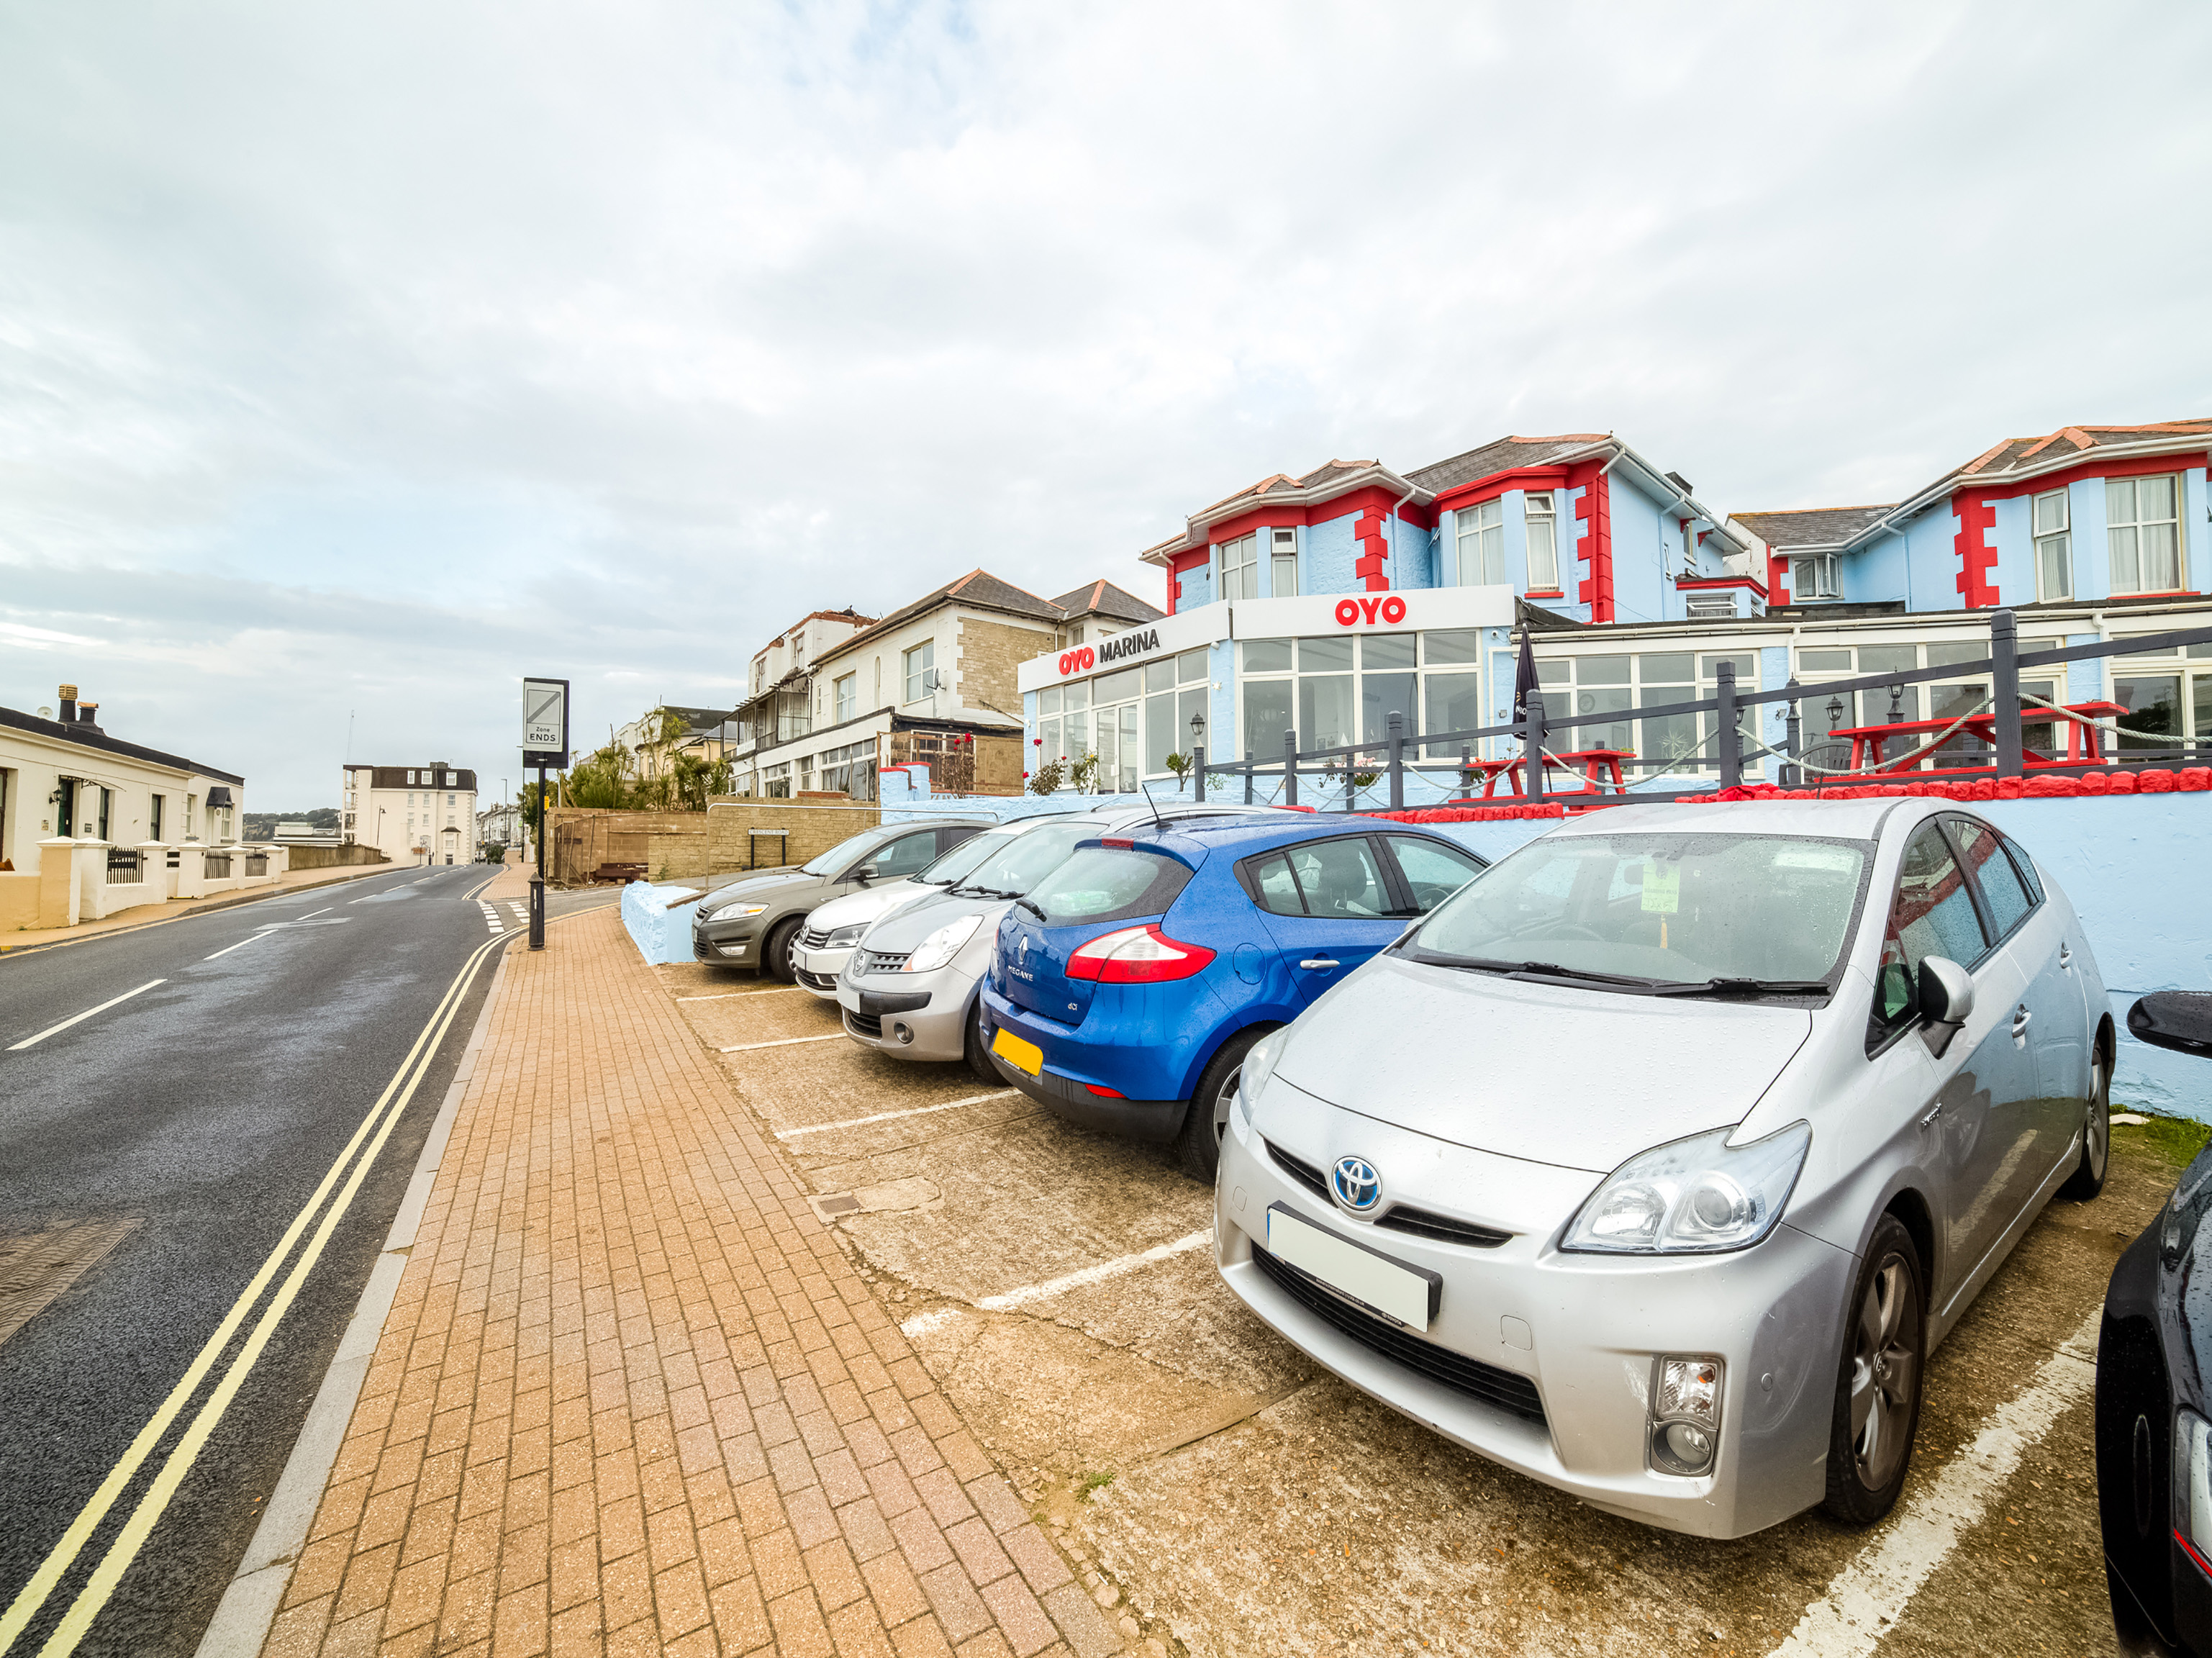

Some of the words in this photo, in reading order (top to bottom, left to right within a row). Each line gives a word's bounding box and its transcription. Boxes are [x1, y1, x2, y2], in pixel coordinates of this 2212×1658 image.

[1335, 596, 1407, 627] OYO
[1059, 646, 1095, 676] OYO
[1100, 628, 1161, 663] MARINA
[530, 733, 556, 742] ENDS
[1007, 965, 1034, 982] MEGANE
[1387, 1314, 1402, 1326] TOYOTA
